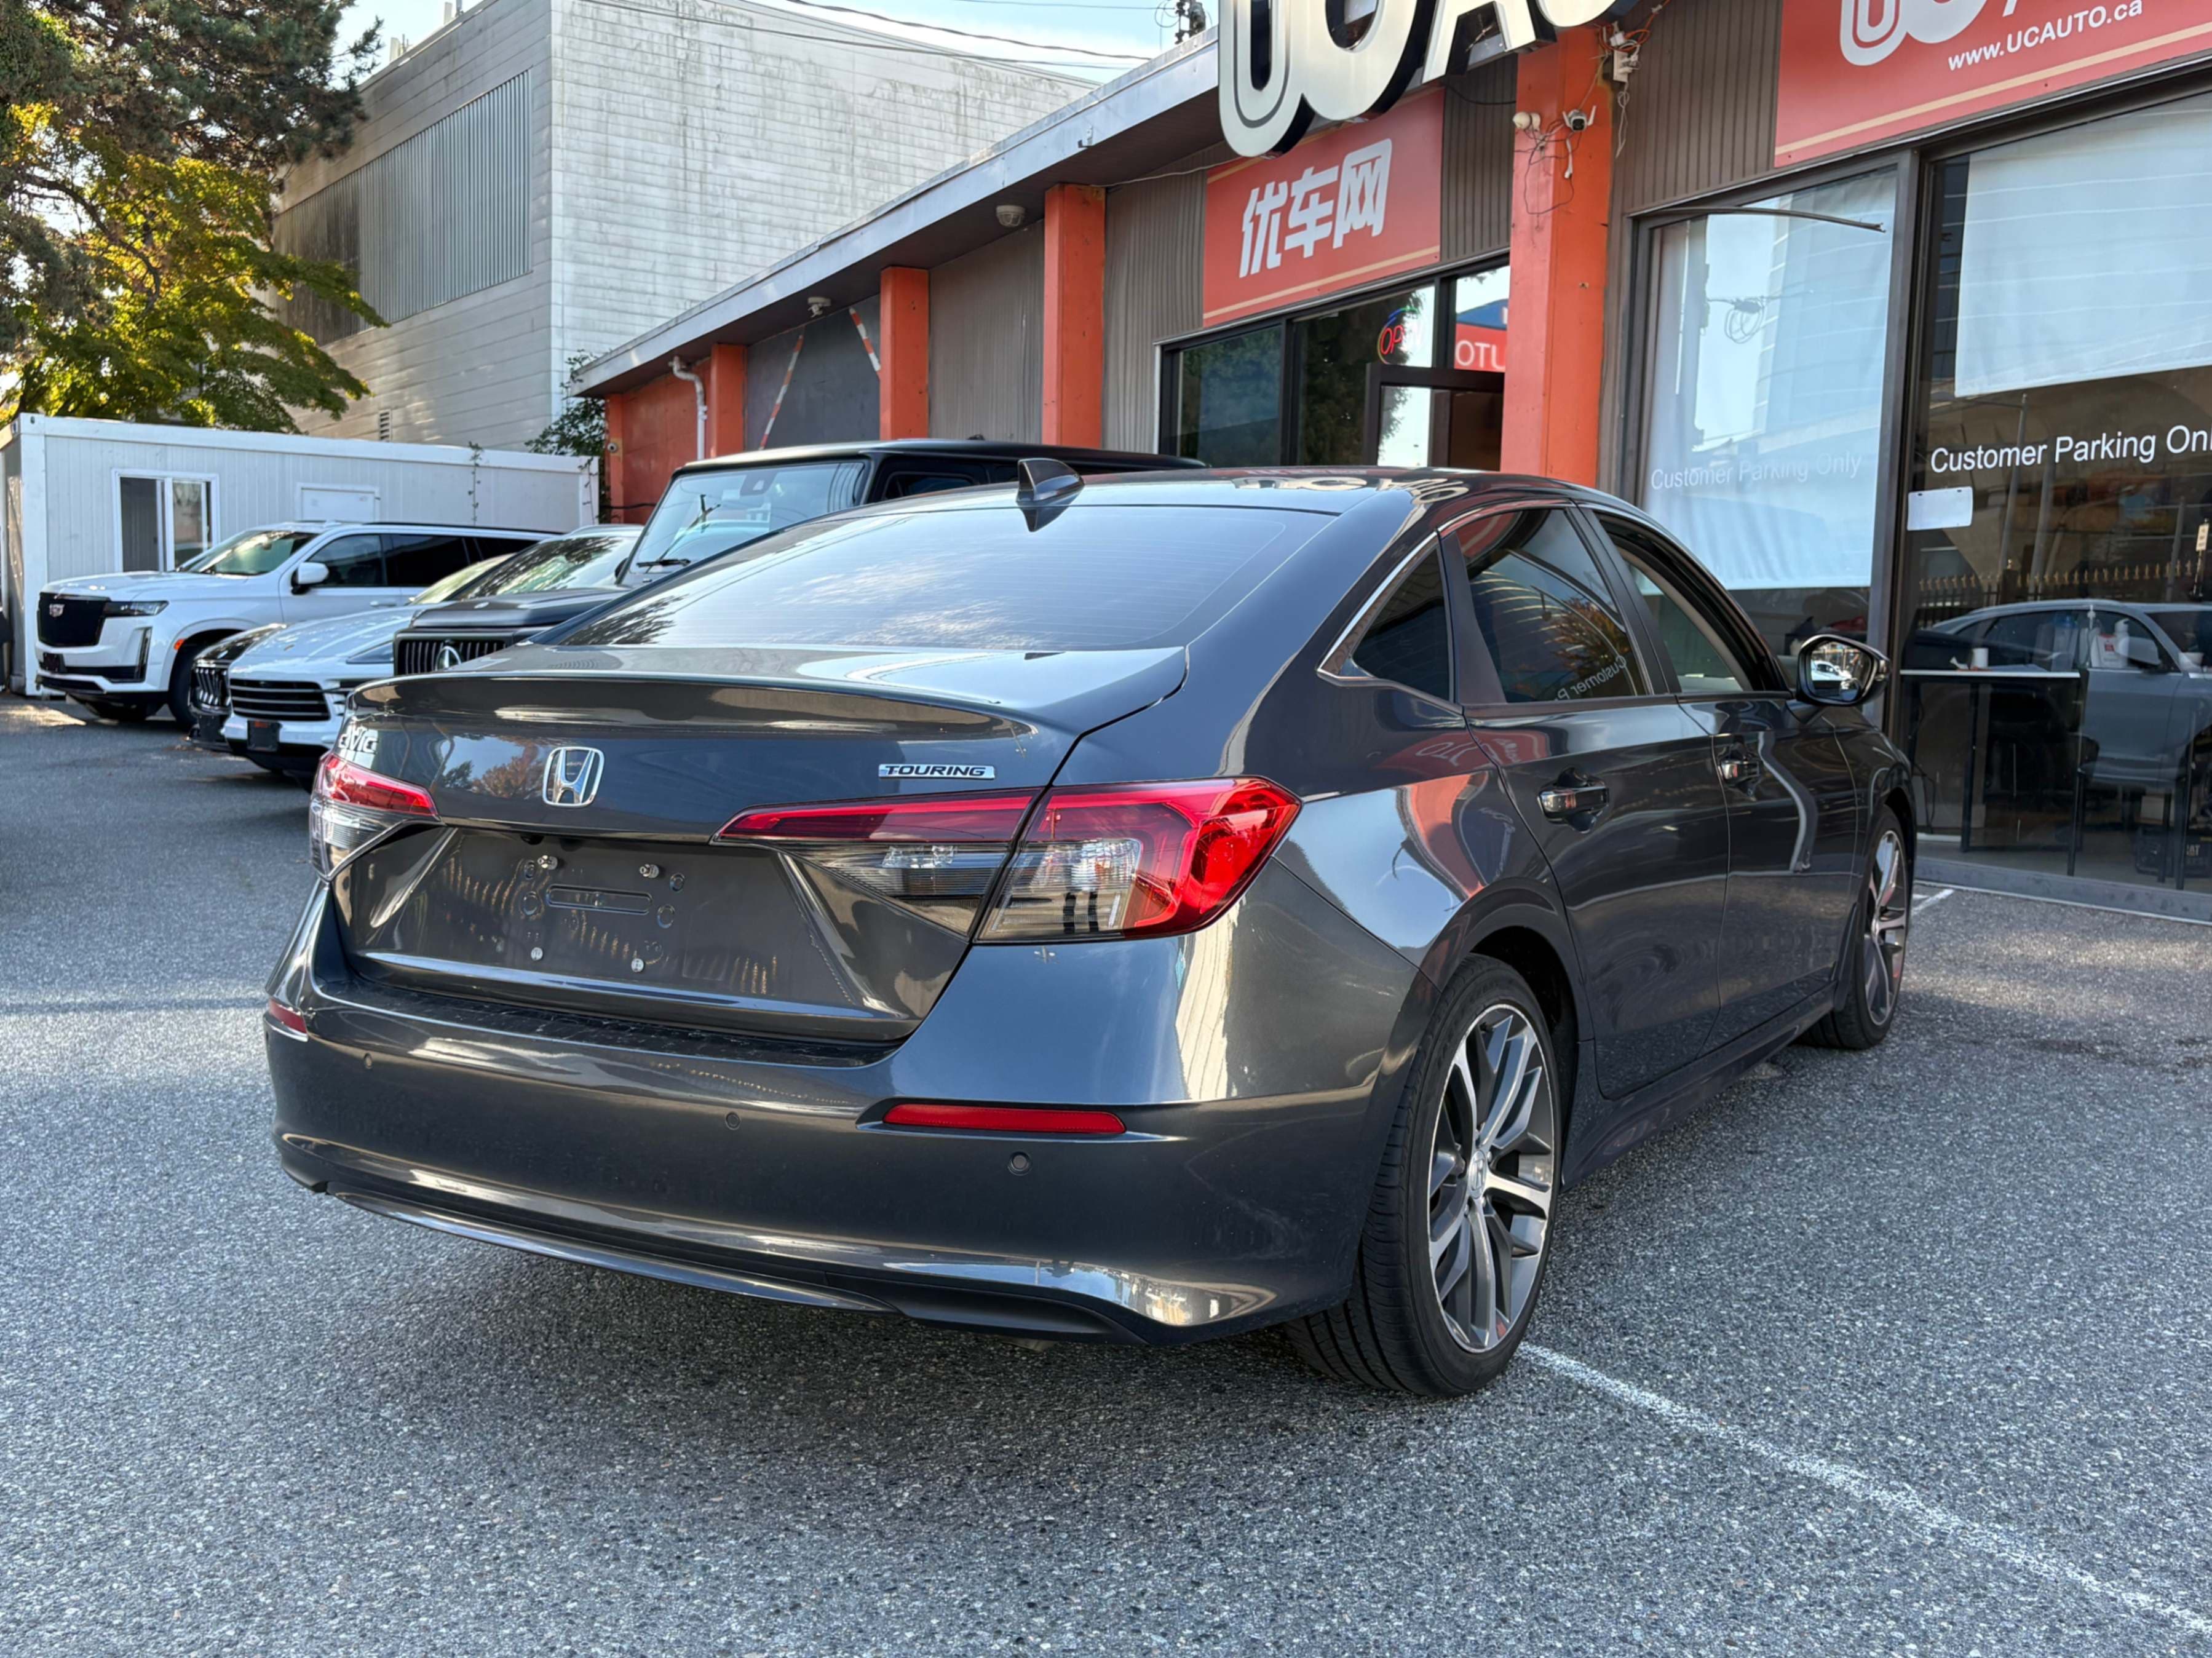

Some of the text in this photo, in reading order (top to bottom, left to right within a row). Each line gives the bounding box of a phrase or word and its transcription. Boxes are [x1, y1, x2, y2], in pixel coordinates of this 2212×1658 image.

[1948, 0, 2143, 71] www.UCAUTO.ca
[1239, 138, 1392, 278] 优车网
[1651, 451, 1861, 490] Customer Parking Only
[1930, 443, 2047, 473] Customer
[2055, 431, 2156, 463] Parking
[886, 765, 986, 776] TOURING
